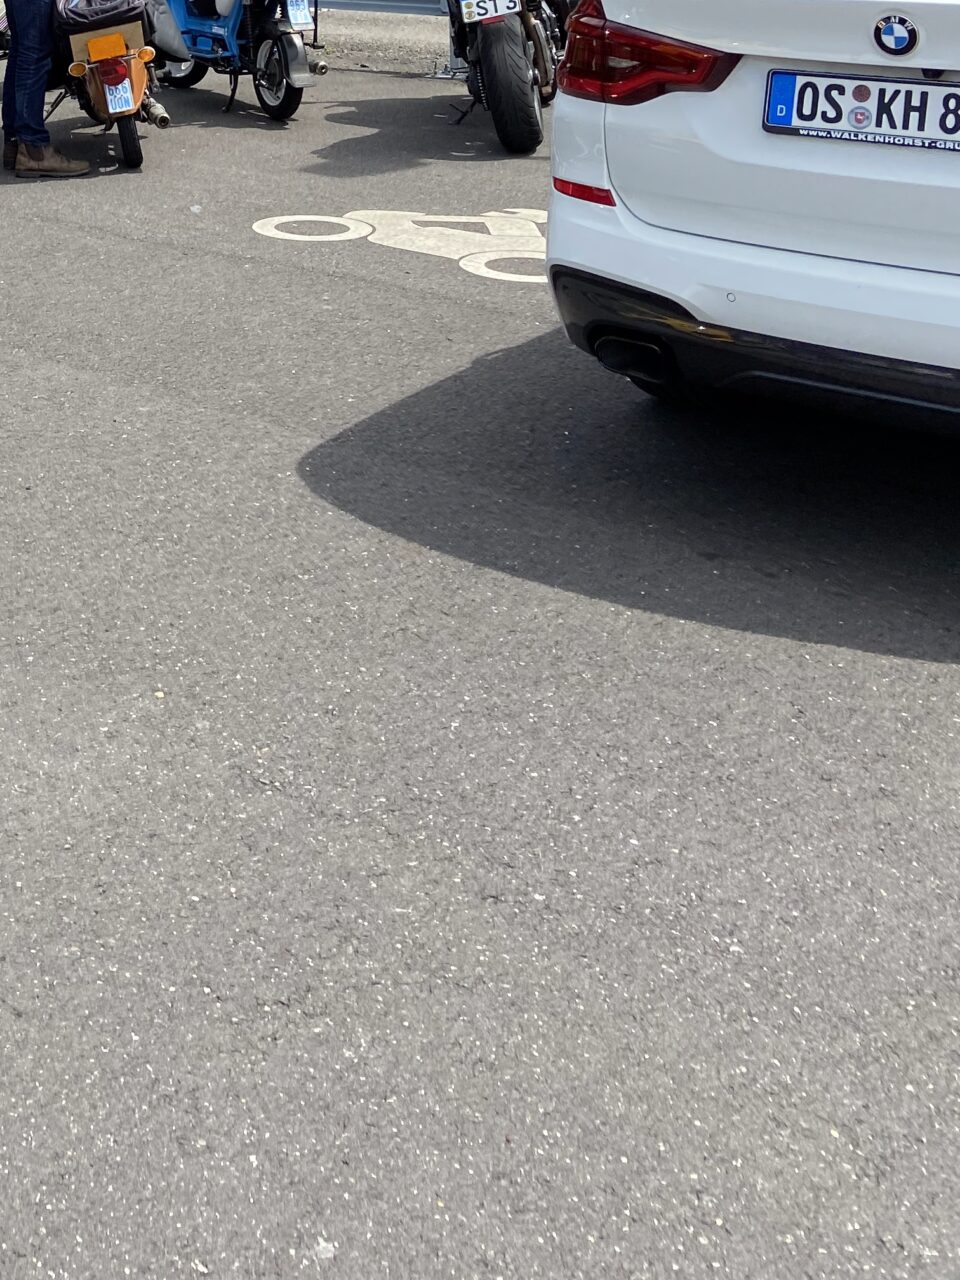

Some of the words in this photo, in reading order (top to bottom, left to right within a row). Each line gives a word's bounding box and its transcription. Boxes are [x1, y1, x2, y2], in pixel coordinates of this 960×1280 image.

[877, 15, 915, 31] BMW
[776, 104, 787, 117] D
[796, 81, 846, 124] OS
[875, 87, 930, 132] KH
[938, 92, 960, 135] 8
